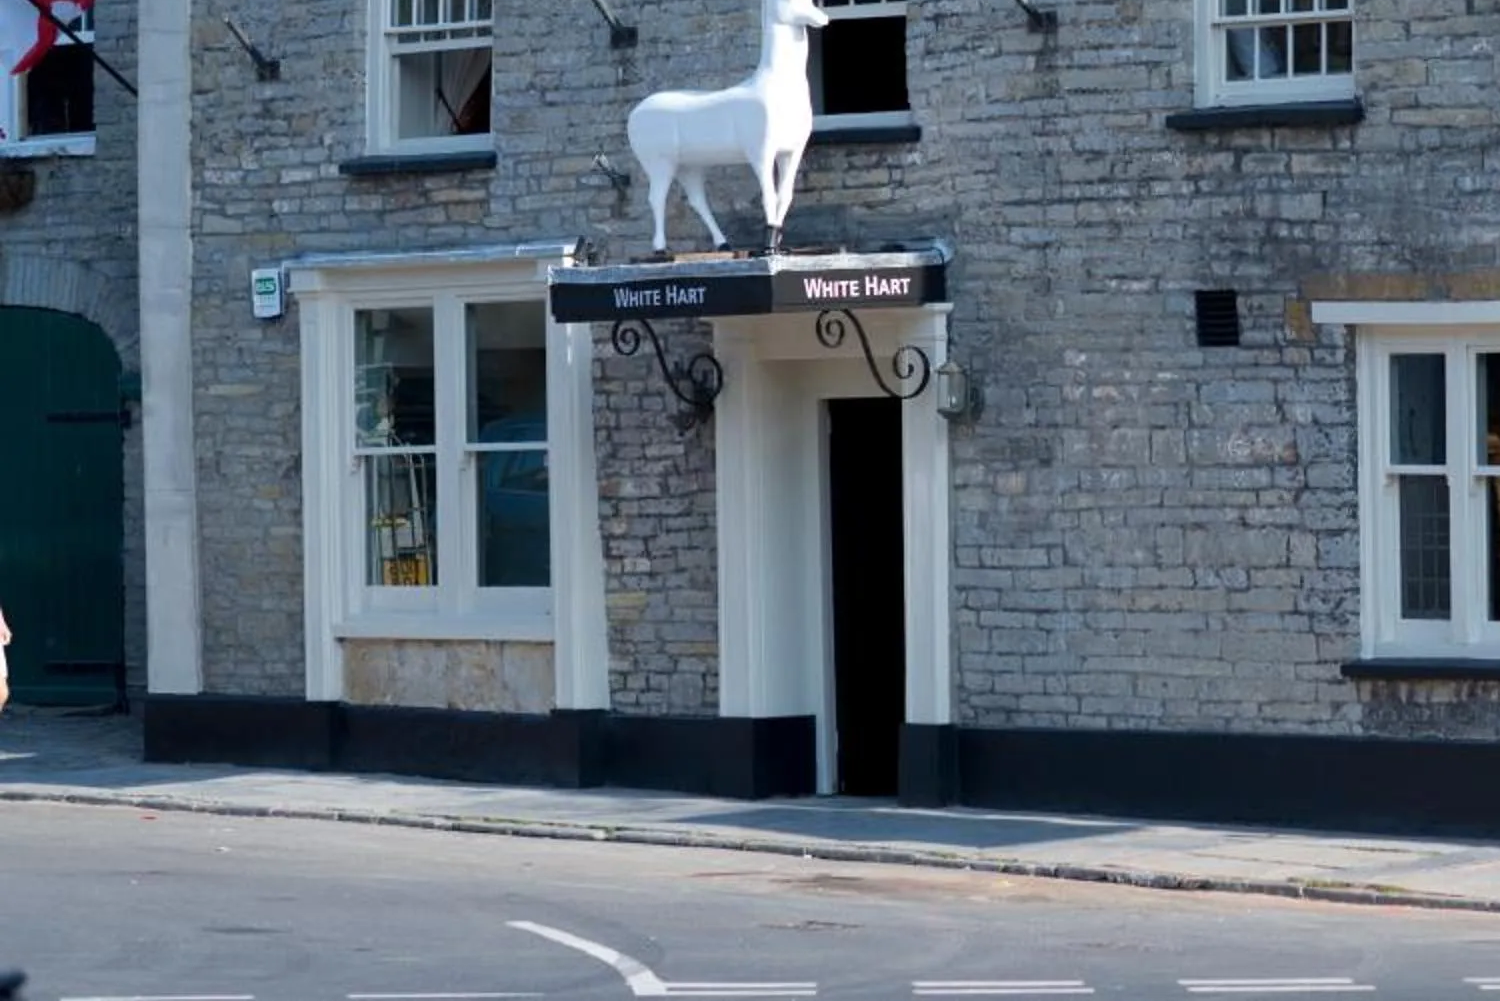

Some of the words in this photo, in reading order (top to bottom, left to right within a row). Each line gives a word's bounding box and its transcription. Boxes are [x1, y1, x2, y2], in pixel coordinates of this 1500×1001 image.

[614, 286, 662, 308] WHITE
[665, 283, 706, 305] HART
[803, 275, 860, 299] WHITE
[864, 275, 911, 296] HART
